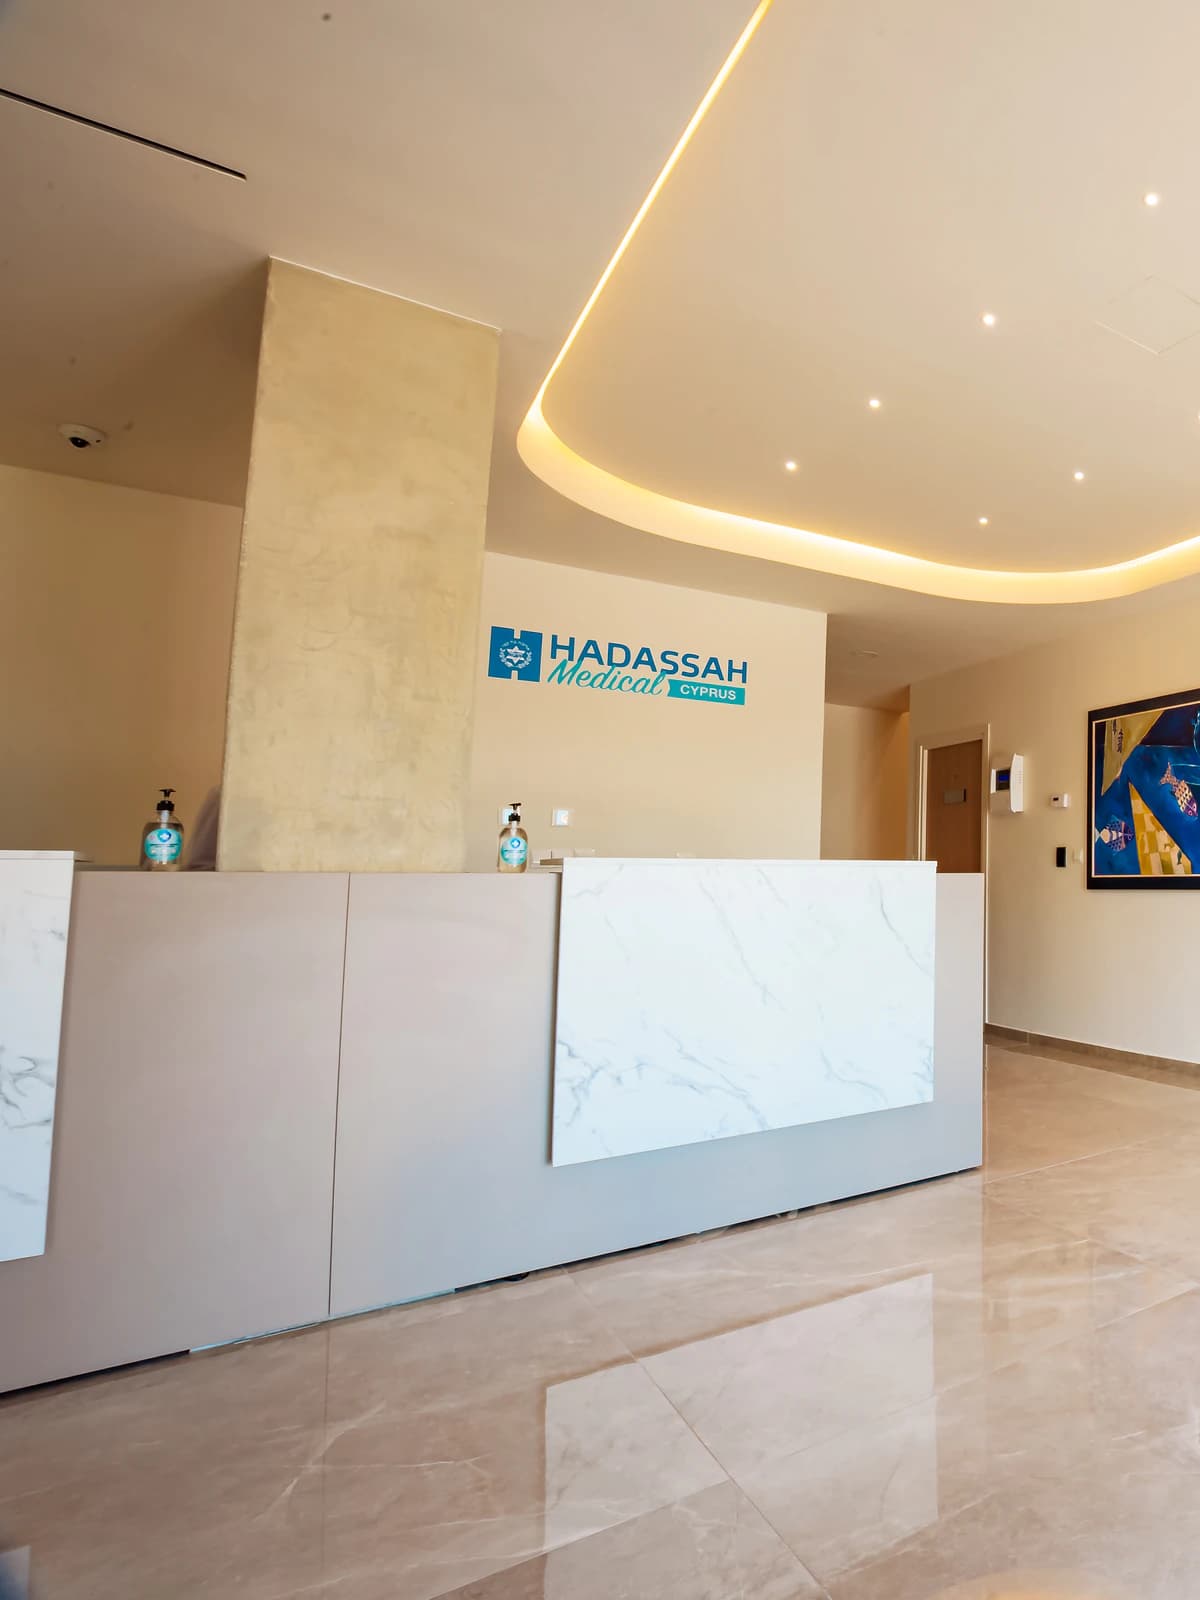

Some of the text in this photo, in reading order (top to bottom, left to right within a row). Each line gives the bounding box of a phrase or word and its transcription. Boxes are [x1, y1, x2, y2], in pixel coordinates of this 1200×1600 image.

[547, 658, 737, 700] Medical CYPRUS
[551, 634, 748, 684] HADASSAH
